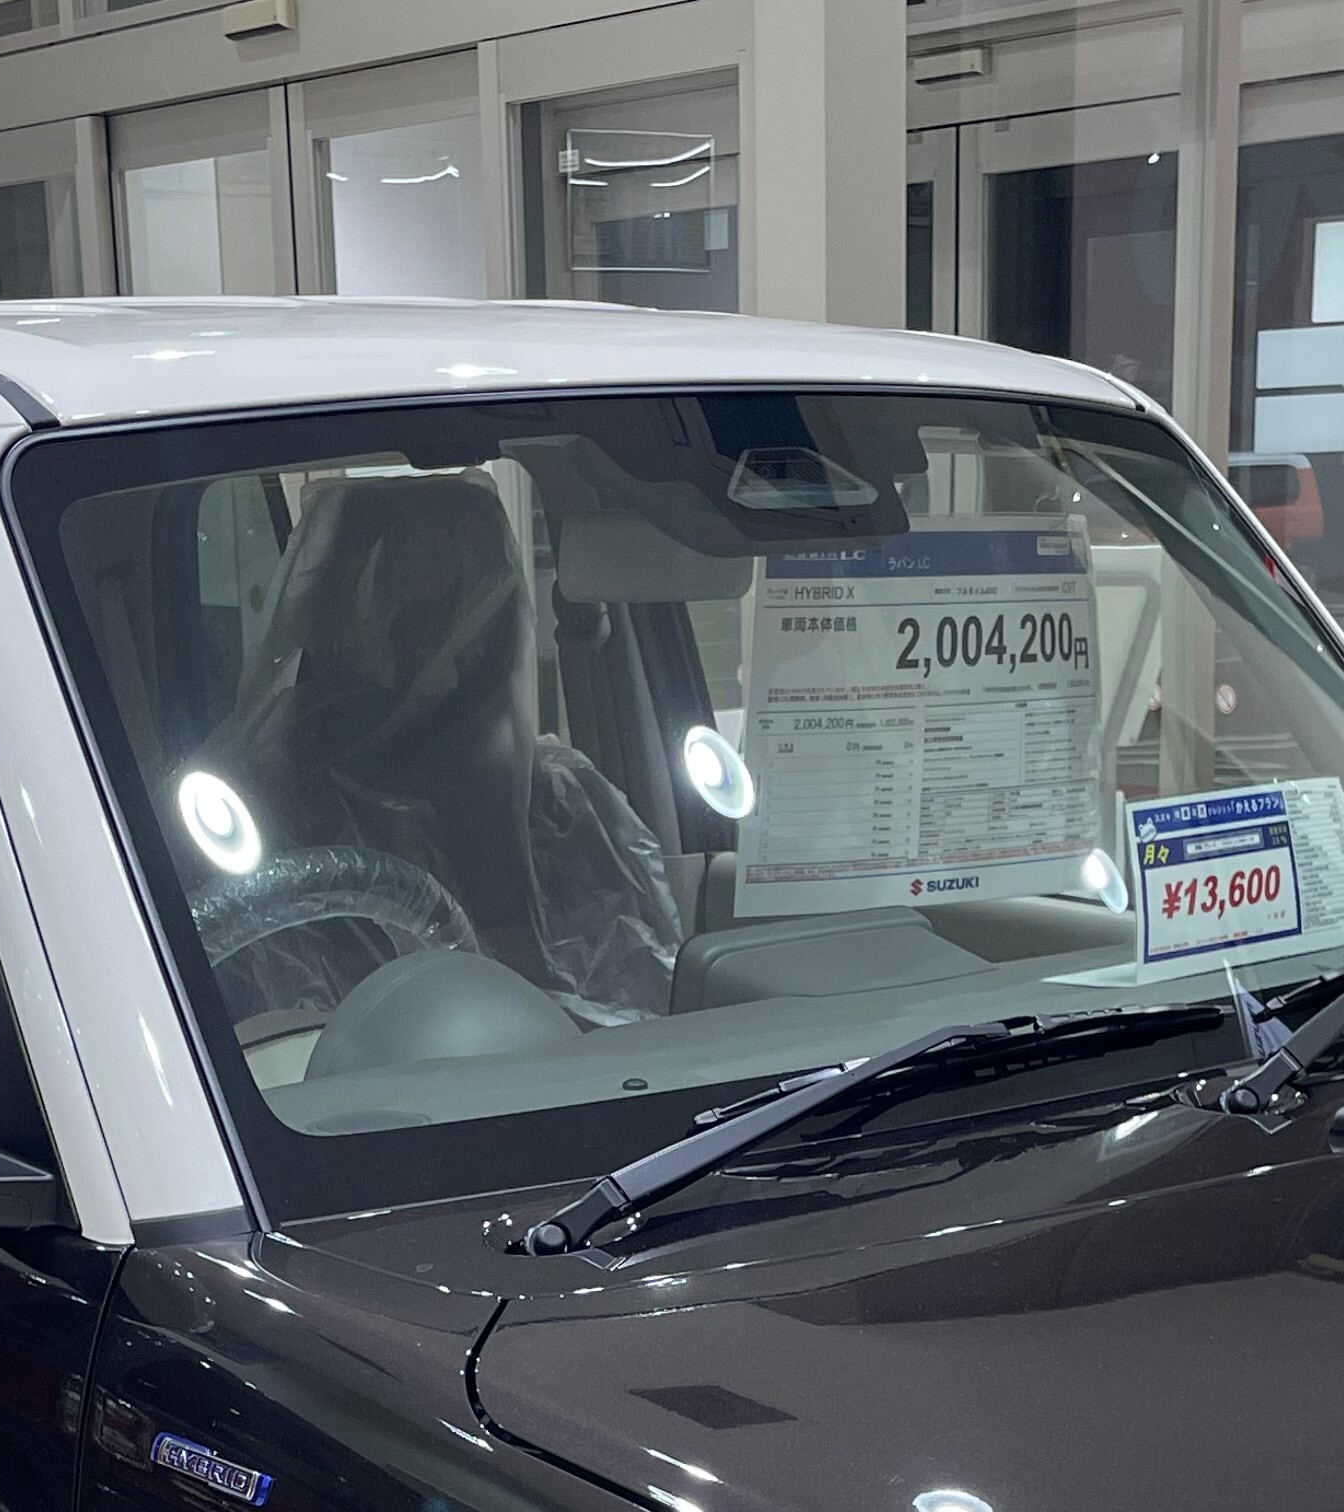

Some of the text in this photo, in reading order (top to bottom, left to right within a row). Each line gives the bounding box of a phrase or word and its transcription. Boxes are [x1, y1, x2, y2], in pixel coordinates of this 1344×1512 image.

[888, 557, 917, 570] ラパン
[794, 586, 844, 600] HYBRID
[847, 586, 855, 599] X
[781, 617, 857, 633] 車両本体価格
[896, 612, 1090, 678] 2,004,200円
[926, 876, 979, 893] SUZUKI
[1162, 864, 1281, 920] ¥13,600
[159, 1443, 248, 1492] HYBRID
